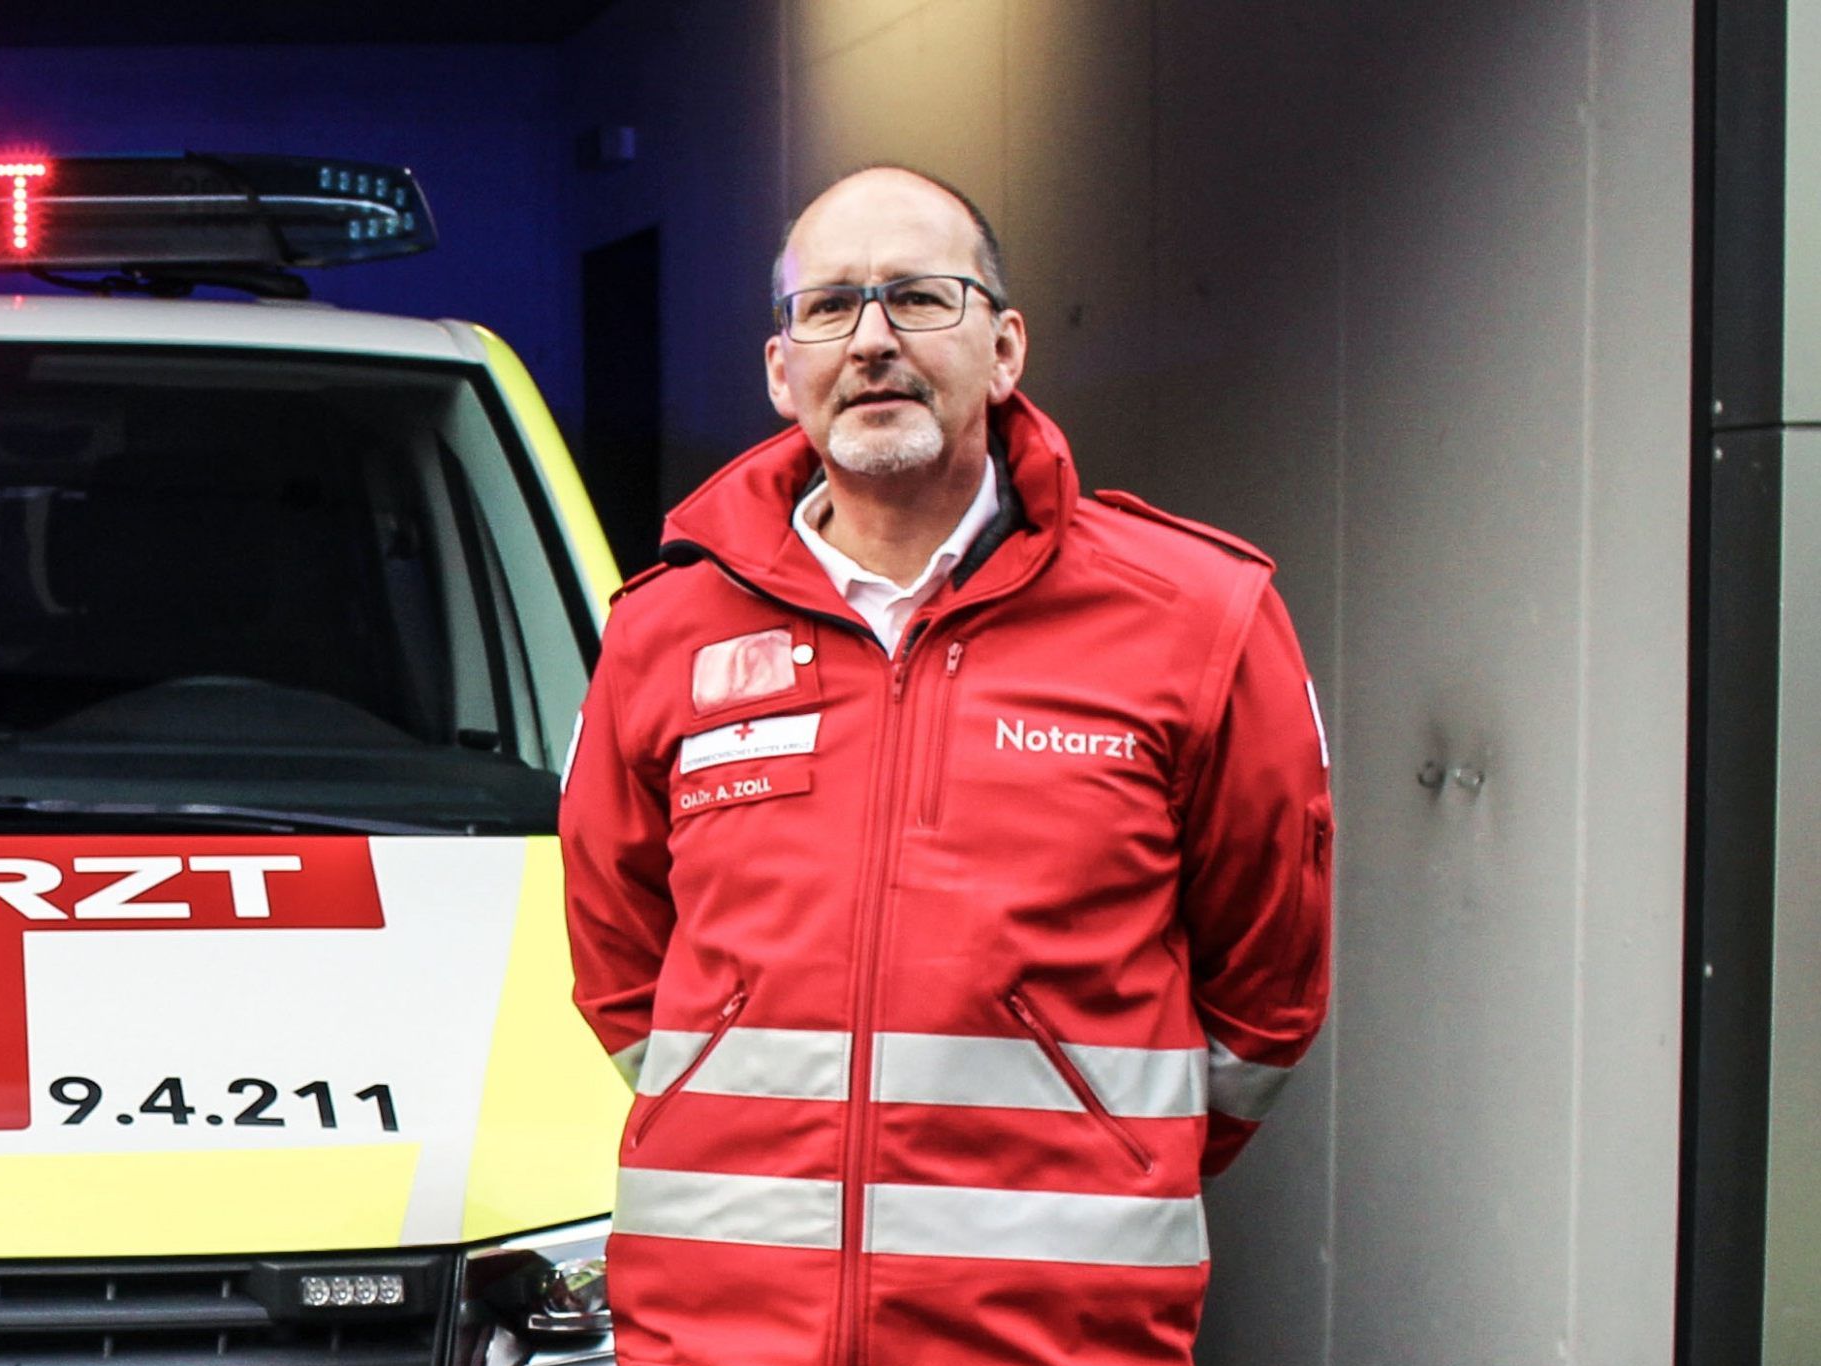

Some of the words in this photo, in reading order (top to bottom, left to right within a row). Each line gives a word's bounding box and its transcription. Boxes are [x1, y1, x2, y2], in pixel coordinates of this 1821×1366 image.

[995, 717, 1137, 760] Notarzt
[734, 777, 772, 798] ZOLL
[48, 1076, 400, 1131] 9.4.211
